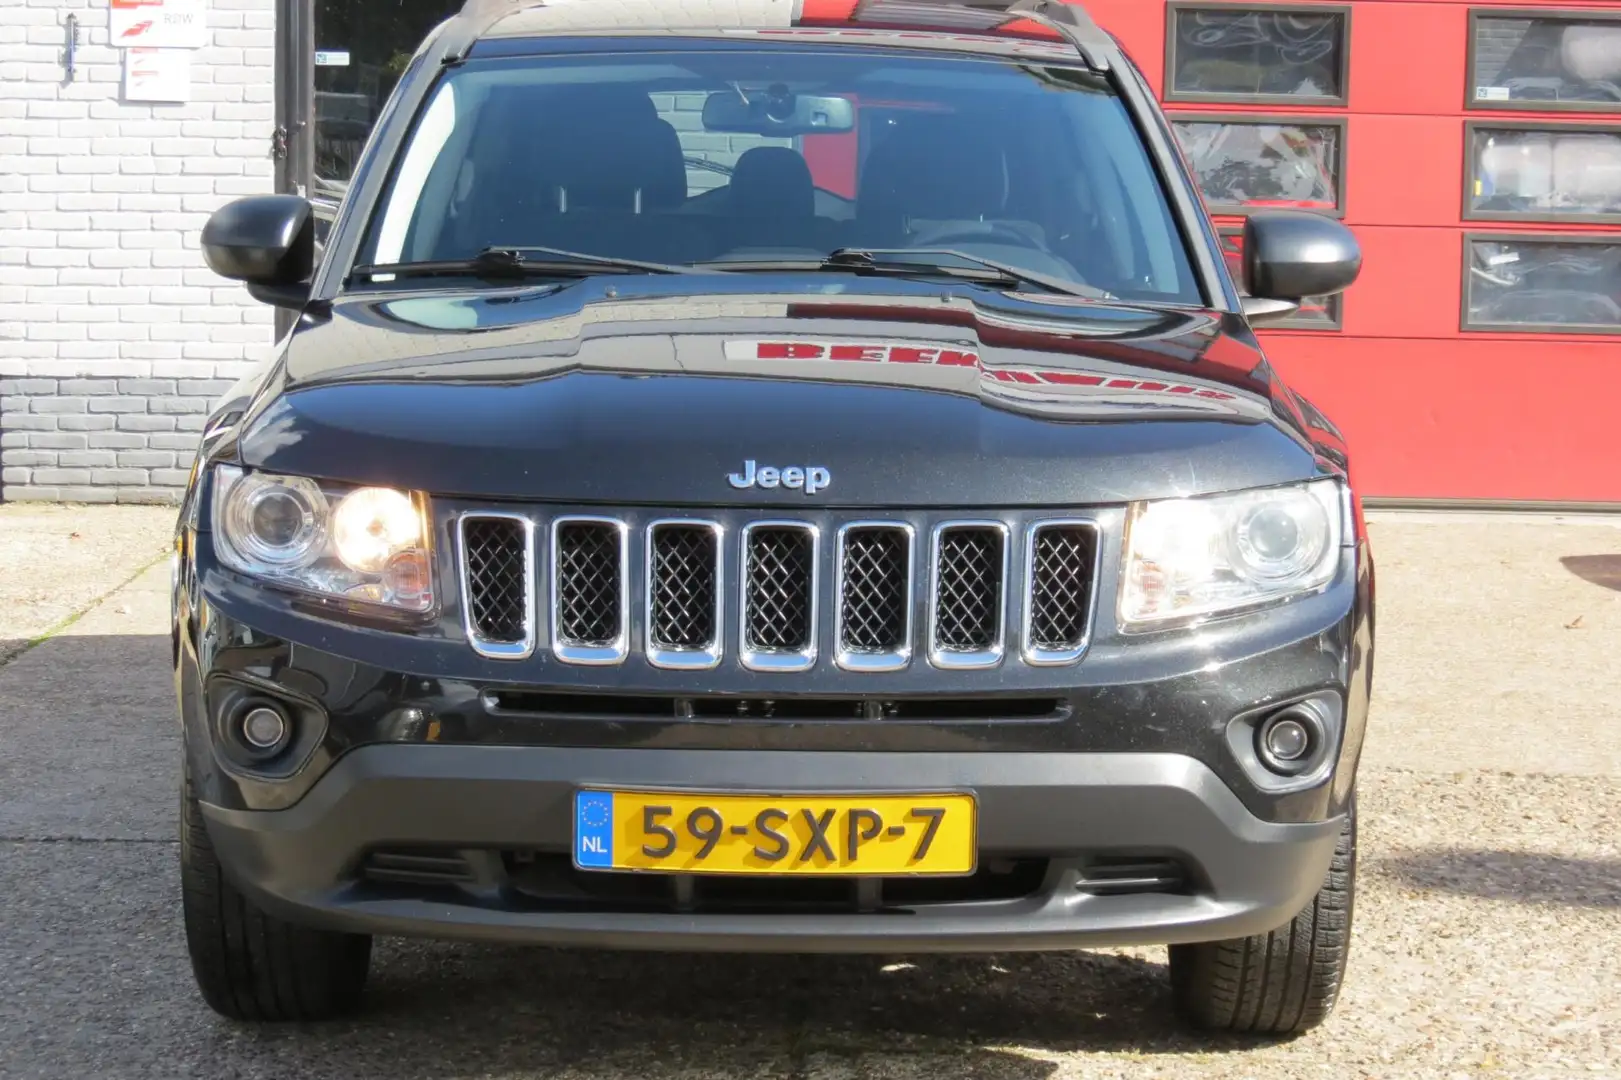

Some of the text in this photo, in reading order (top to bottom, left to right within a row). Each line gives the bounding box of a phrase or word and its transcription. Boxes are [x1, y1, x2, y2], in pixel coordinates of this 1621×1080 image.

[728, 460, 830, 494] Jeep
[582, 836, 607, 854] NL
[642, 805, 946, 861] 59-SXP-7
